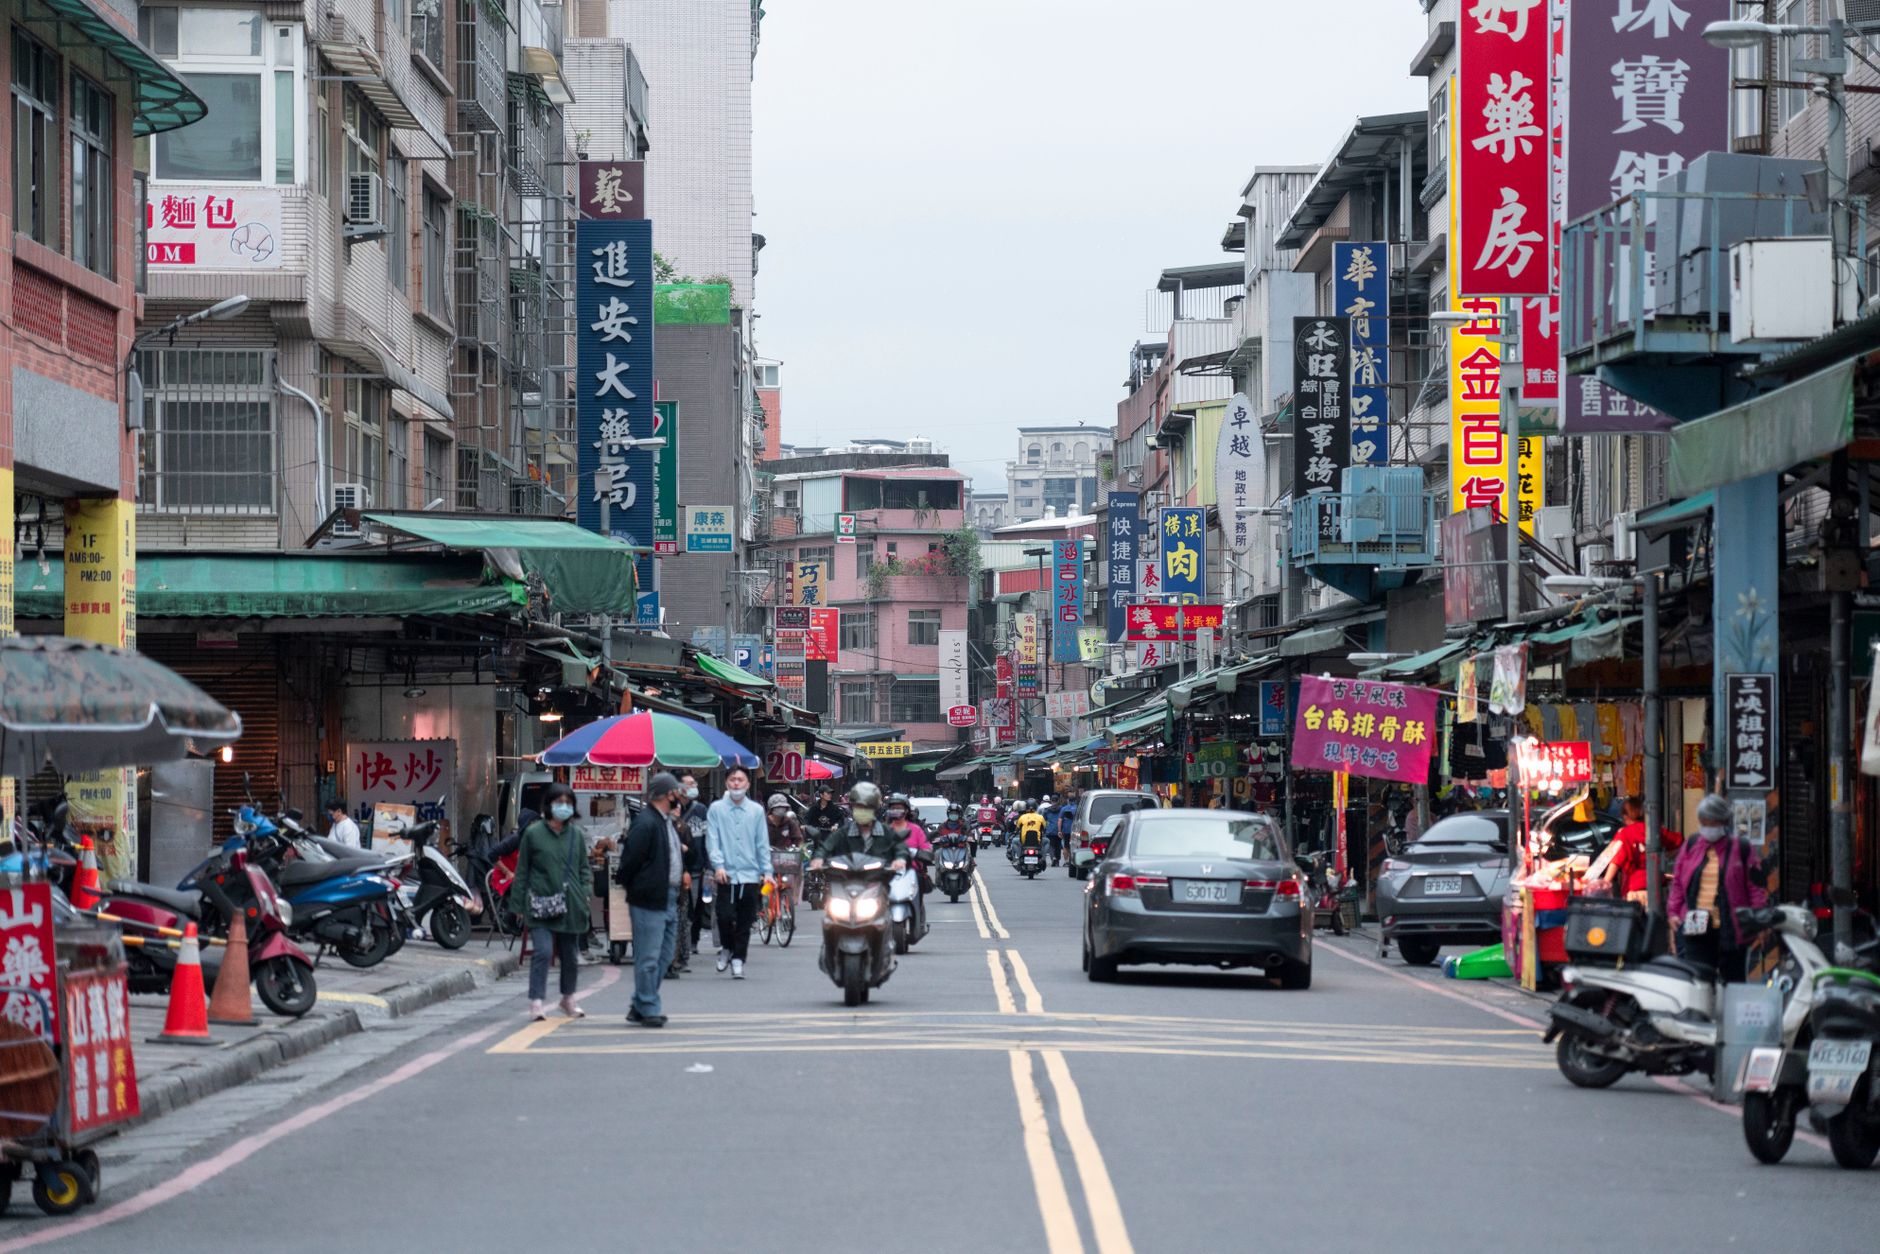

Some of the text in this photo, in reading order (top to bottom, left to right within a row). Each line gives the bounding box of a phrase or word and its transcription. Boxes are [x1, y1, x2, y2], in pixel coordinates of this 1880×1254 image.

[590, 167, 633, 214] 藝
[1305, 321, 1339, 378] 永旺
[588, 240, 640, 511] 進安大藥局
[1300, 380, 1319, 419] 綜合
[1323, 380, 1341, 419] 會計師
[1229, 406, 1251, 458] 卓越
[82, 533, 97, 548] 1F
[80, 570, 112, 582] PM2:00
[1111, 516, 1132, 608] 快捷通信
[799, 564, 820, 606] 巧麗
[1333, 681, 1407, 708] 古早風味
[1303, 704, 1427, 746] 台南排骨酥
[1735, 678, 1766, 770] 三峽祖師廟
[356, 749, 443, 793] 快炒
[767, 751, 803, 782] 20
